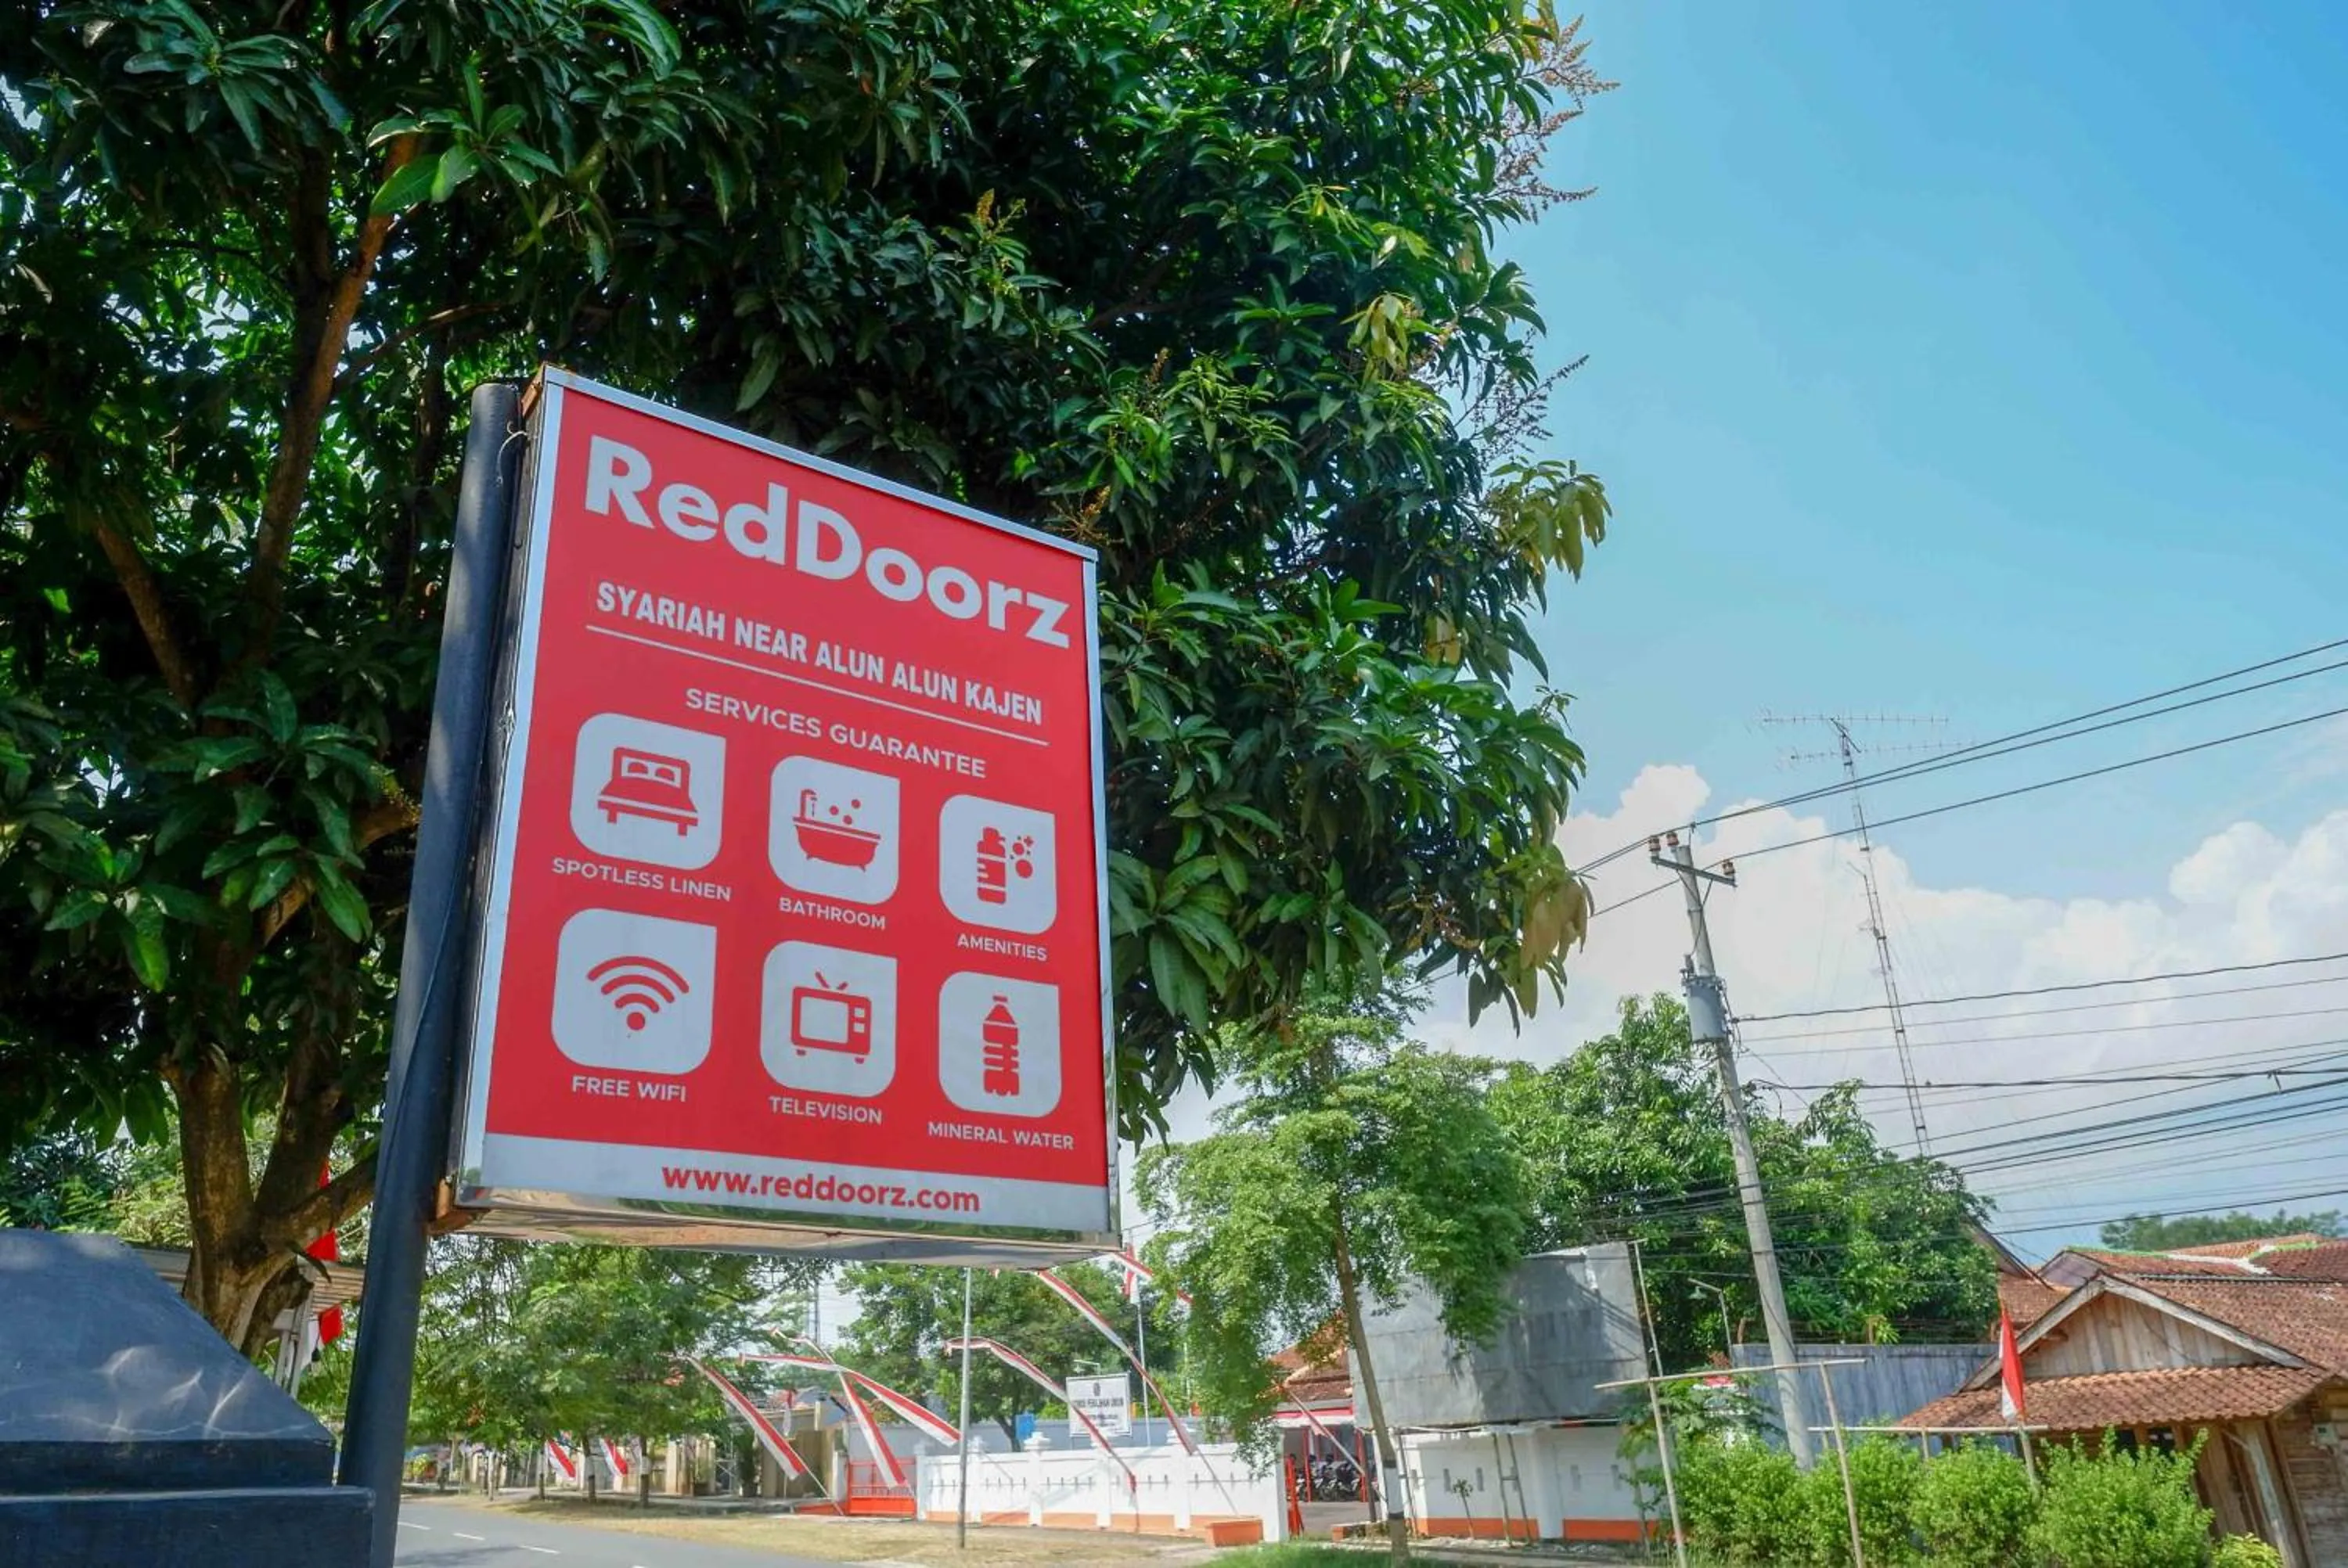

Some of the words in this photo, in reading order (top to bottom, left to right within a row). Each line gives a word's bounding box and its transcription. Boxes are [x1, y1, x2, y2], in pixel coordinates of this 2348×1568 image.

[584, 434, 1071, 649] RedDoorz
[596, 581, 726, 642] SYARIAH
[734, 617, 808, 664] NEAR
[814, 641, 884, 684] ALUN
[891, 662, 958, 704] ALUN
[964, 680, 1043, 726] KAJEN
[686, 687, 822, 738] SERVICES
[829, 723, 986, 779] GUARANTEE
[553, 858, 664, 890] SPOTLESS
[670, 877, 731, 901] LINEN
[780, 897, 886, 930] BATHROOM
[957, 933, 1047, 962] AMENITIES
[572, 1075, 629, 1097] FREE
[637, 1082, 686, 1102] WIFI
[769, 1096, 882, 1124] TELEVISION
[928, 1122, 1007, 1145] MINERAL
[1014, 1131, 1074, 1150] WATER
[662, 1167, 980, 1212] www.reddoorz.com
